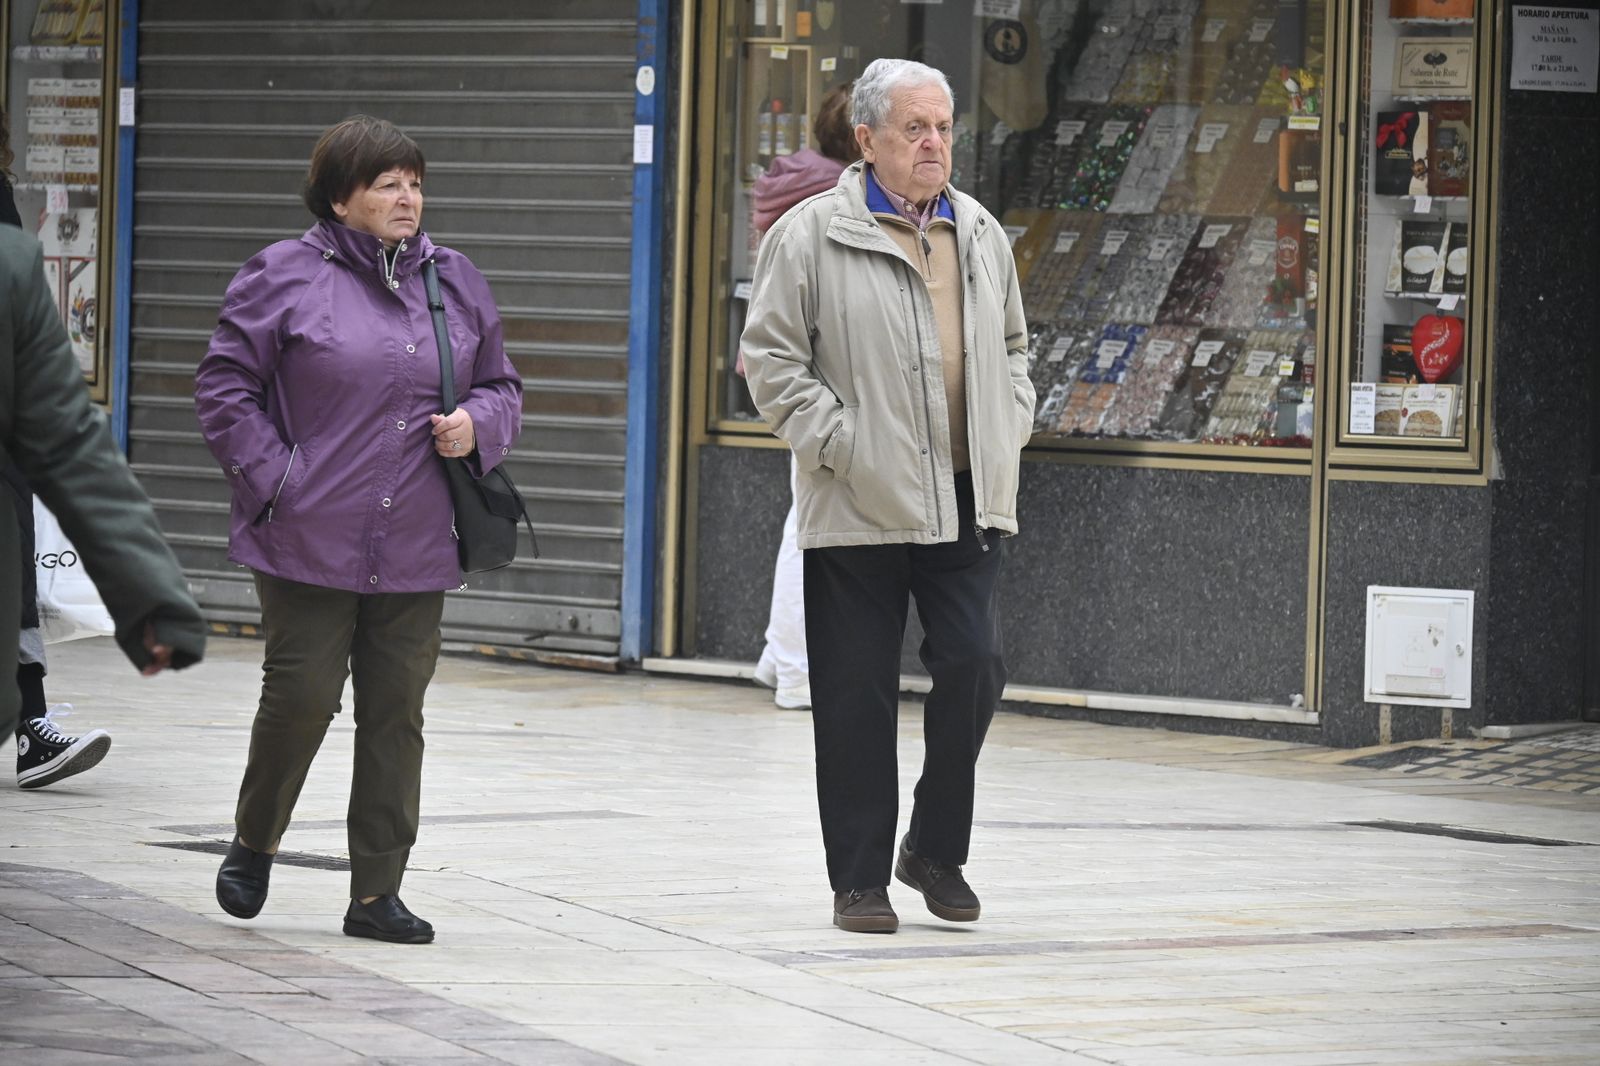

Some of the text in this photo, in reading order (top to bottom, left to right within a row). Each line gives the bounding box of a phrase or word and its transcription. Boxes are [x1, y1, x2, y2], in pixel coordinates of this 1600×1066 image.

[1518, 9, 1589, 20] HORARIO APERTURA
[1541, 24, 1568, 34] MAÑANA
[1541, 55, 1562, 63] TARDE
